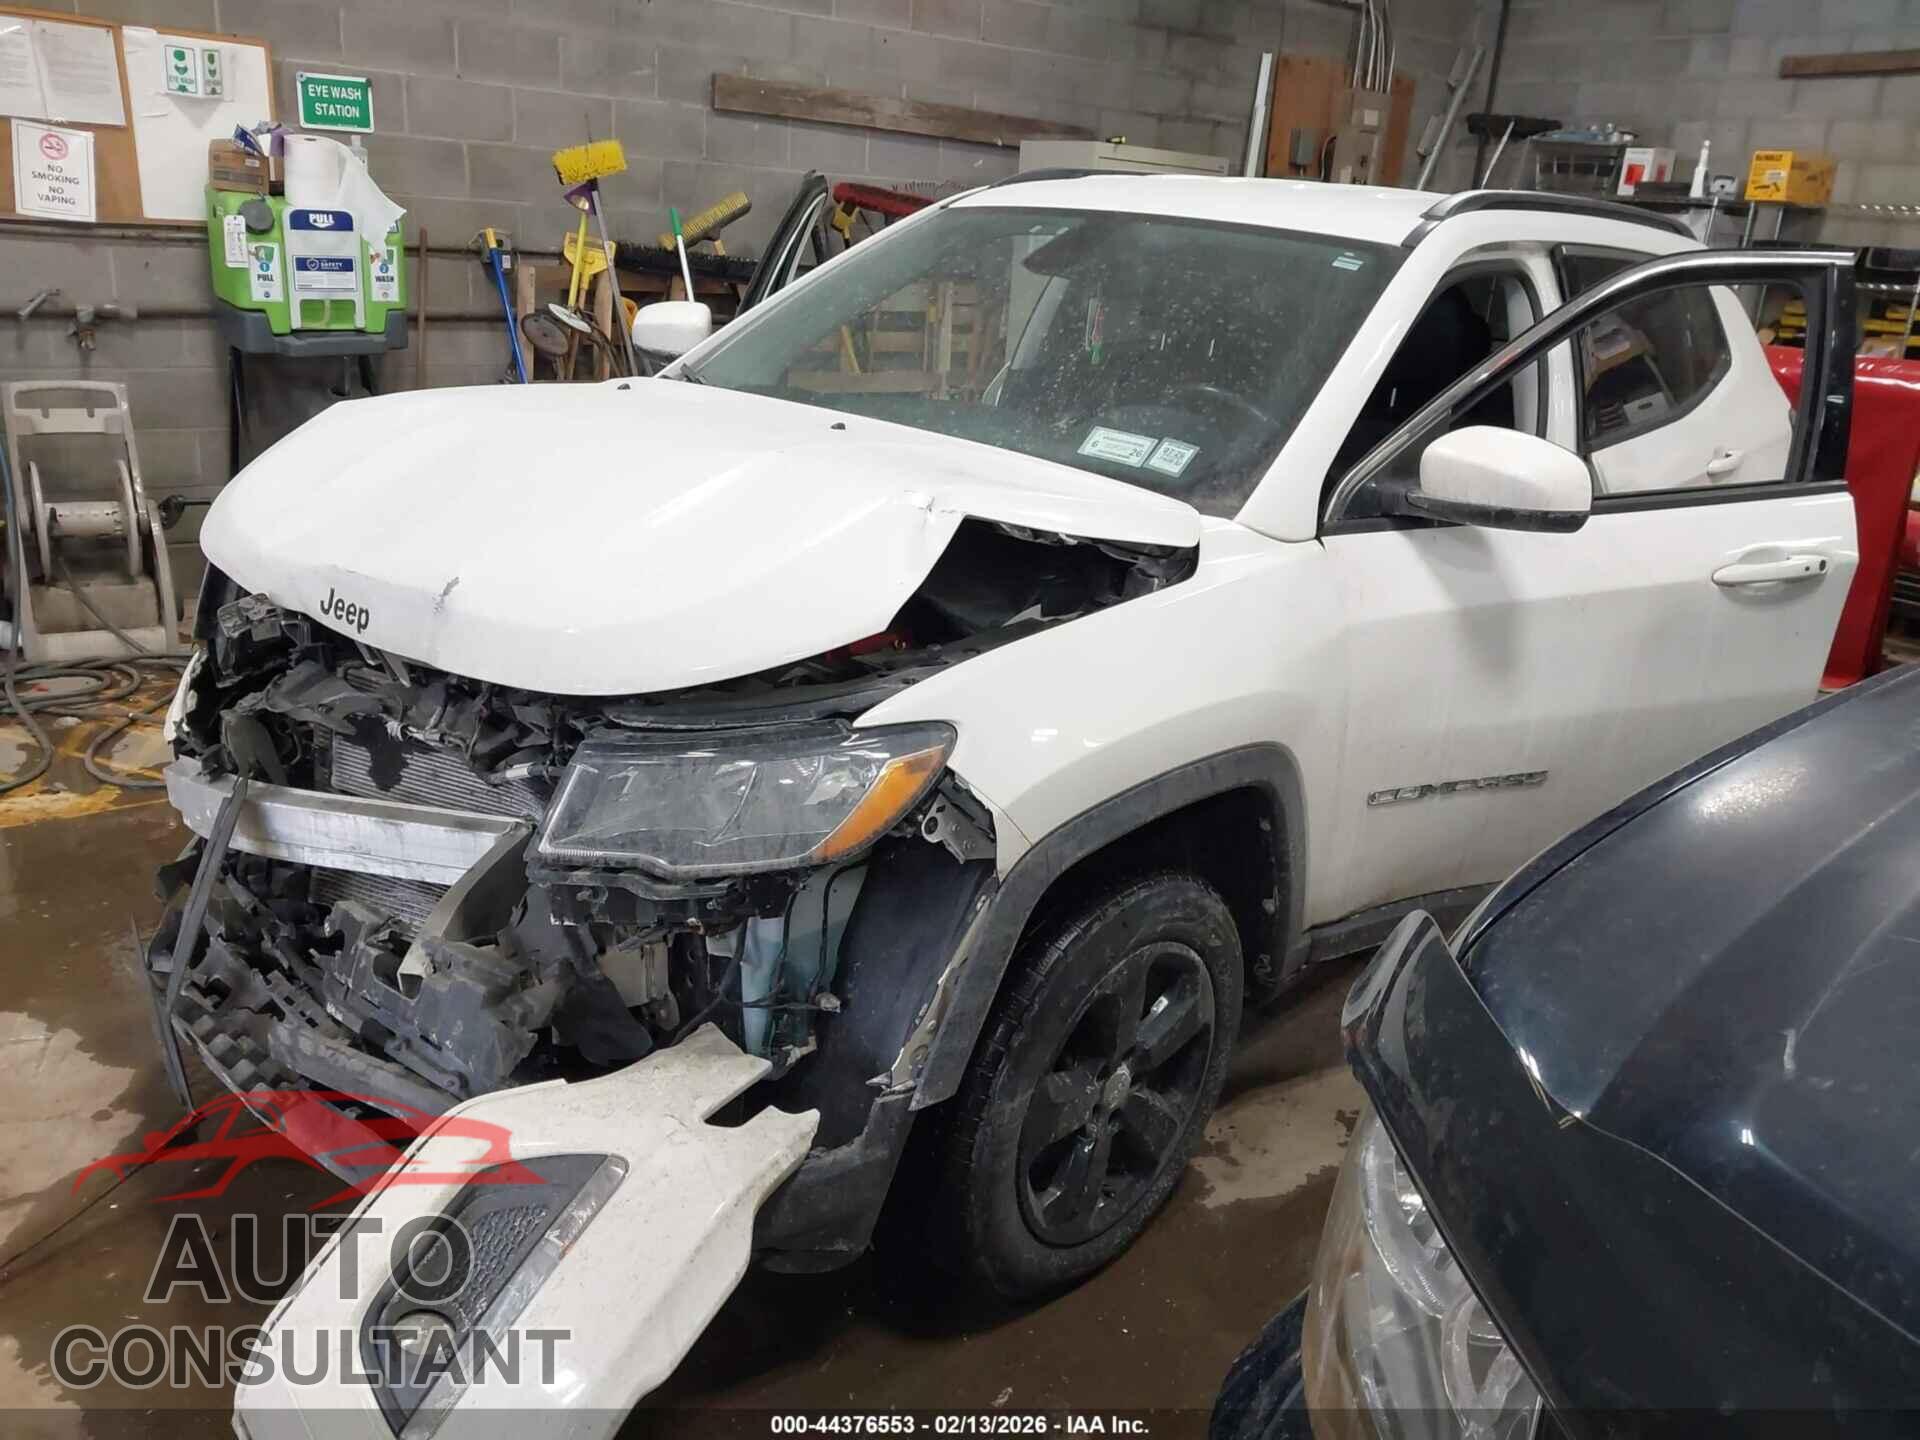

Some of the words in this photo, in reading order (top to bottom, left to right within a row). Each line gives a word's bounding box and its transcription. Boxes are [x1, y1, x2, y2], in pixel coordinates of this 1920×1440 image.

[308, 83, 329, 98] EYE
[330, 85, 362, 100] WASH
[315, 102, 360, 118] STATION
[47, 164, 63, 173] NO
[31, 171, 80, 185] SMOKING
[48, 186, 64, 195] NO
[37, 192, 76, 205] VAPING
[308, 213, 335, 225] PULL
[257, 273, 275, 282] PULL
[320, 587, 370, 635] Jeep
